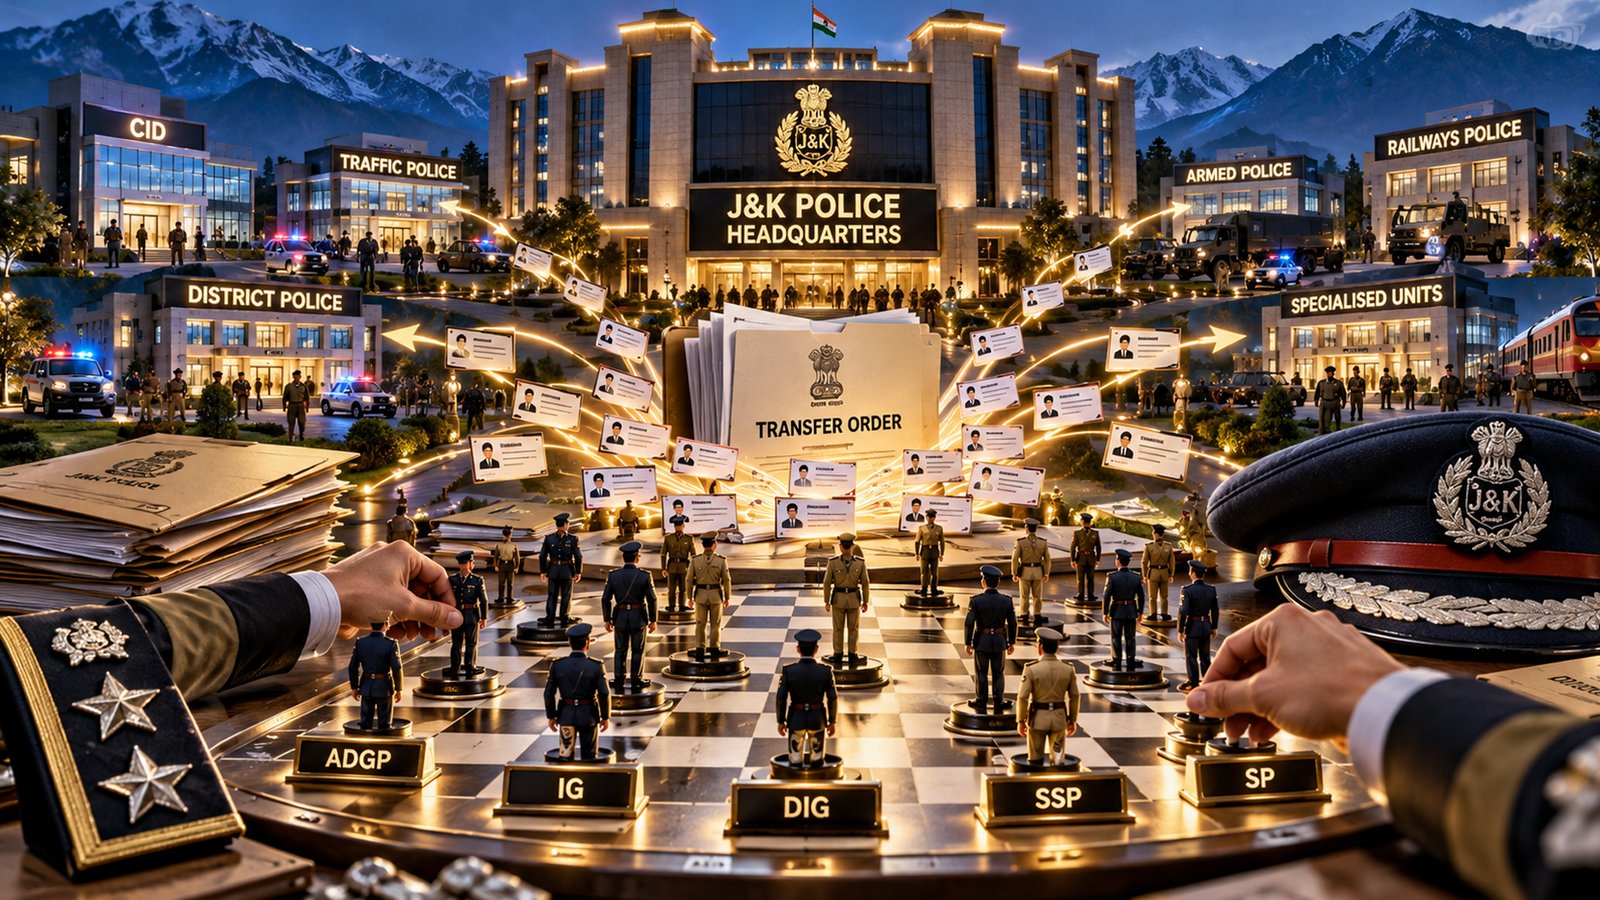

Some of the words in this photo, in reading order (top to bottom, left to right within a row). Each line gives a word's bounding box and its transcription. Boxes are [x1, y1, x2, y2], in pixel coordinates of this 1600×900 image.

[129, 117, 166, 140] CID
[1388, 130, 1460, 156] RAILWAYS
[1464, 119, 1522, 144] POLICE
[798, 133, 830, 149] J&K
[340, 153, 402, 175] TRAFFIC
[406, 160, 457, 179] POLICE
[1186, 166, 1237, 183] ARMED
[1241, 162, 1292, 180] POLICE
[727, 193, 786, 219] J&K
[796, 193, 901, 219] POLICE
[727, 224, 902, 246] HEADQUARTERS
[188, 285, 275, 308] DISTRICT
[280, 291, 343, 311] POLICE
[1291, 289, 1388, 314] SPECIALISED
[1391, 284, 1443, 306] UNITS
[755, 417, 843, 439] TRANSFER
[847, 413, 902, 433] ORDER
[1468, 489, 1518, 514] J&K
[325, 748, 392, 770] ADGP
[557, 777, 584, 800] IG
[1245, 767, 1275, 789] SP
[783, 796, 830, 818] DIG
[1035, 787, 1082, 810] SSP
